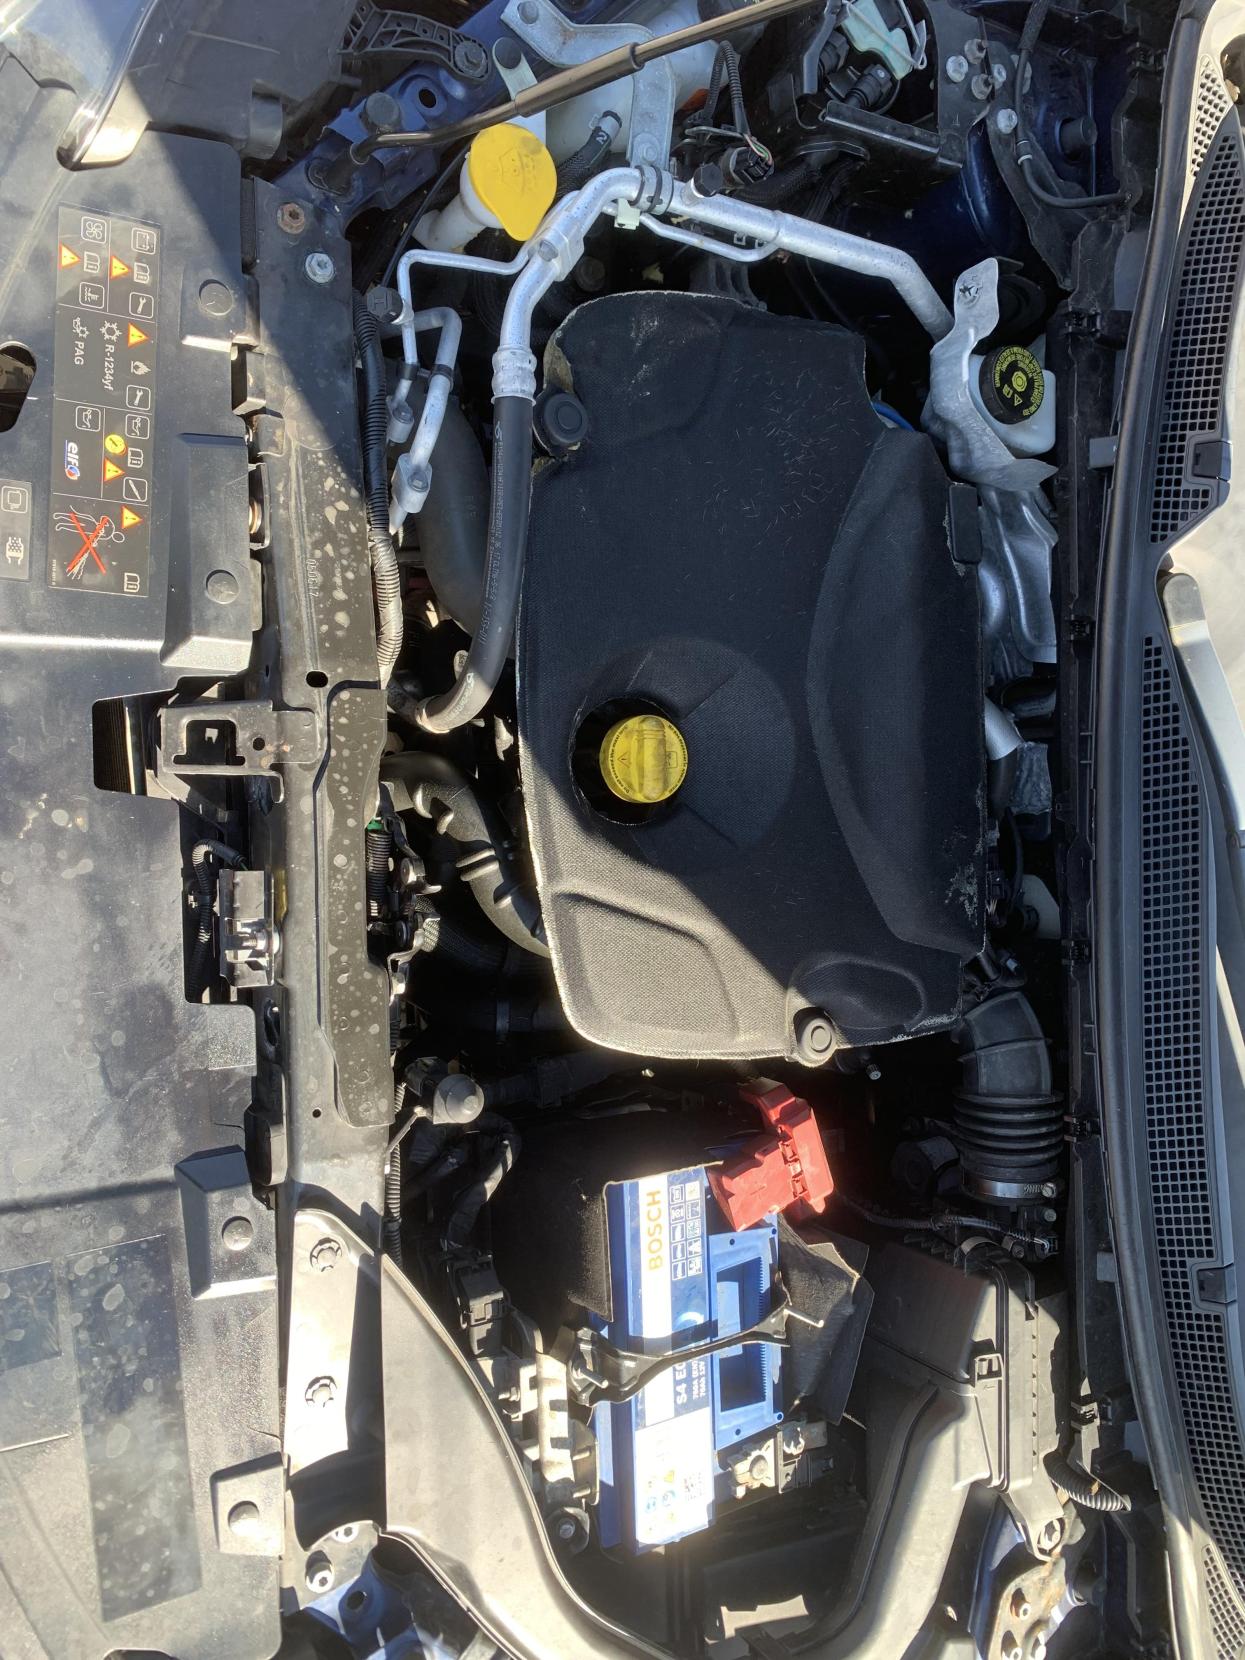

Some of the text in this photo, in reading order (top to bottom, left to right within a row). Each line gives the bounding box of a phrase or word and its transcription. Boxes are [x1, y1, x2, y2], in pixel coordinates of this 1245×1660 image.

[74, 341, 85, 365] PAG
[102, 344, 116, 391] R-1234yf
[647, 1190, 663, 1271] BOSCH
[676, 1381, 687, 1405] S4
